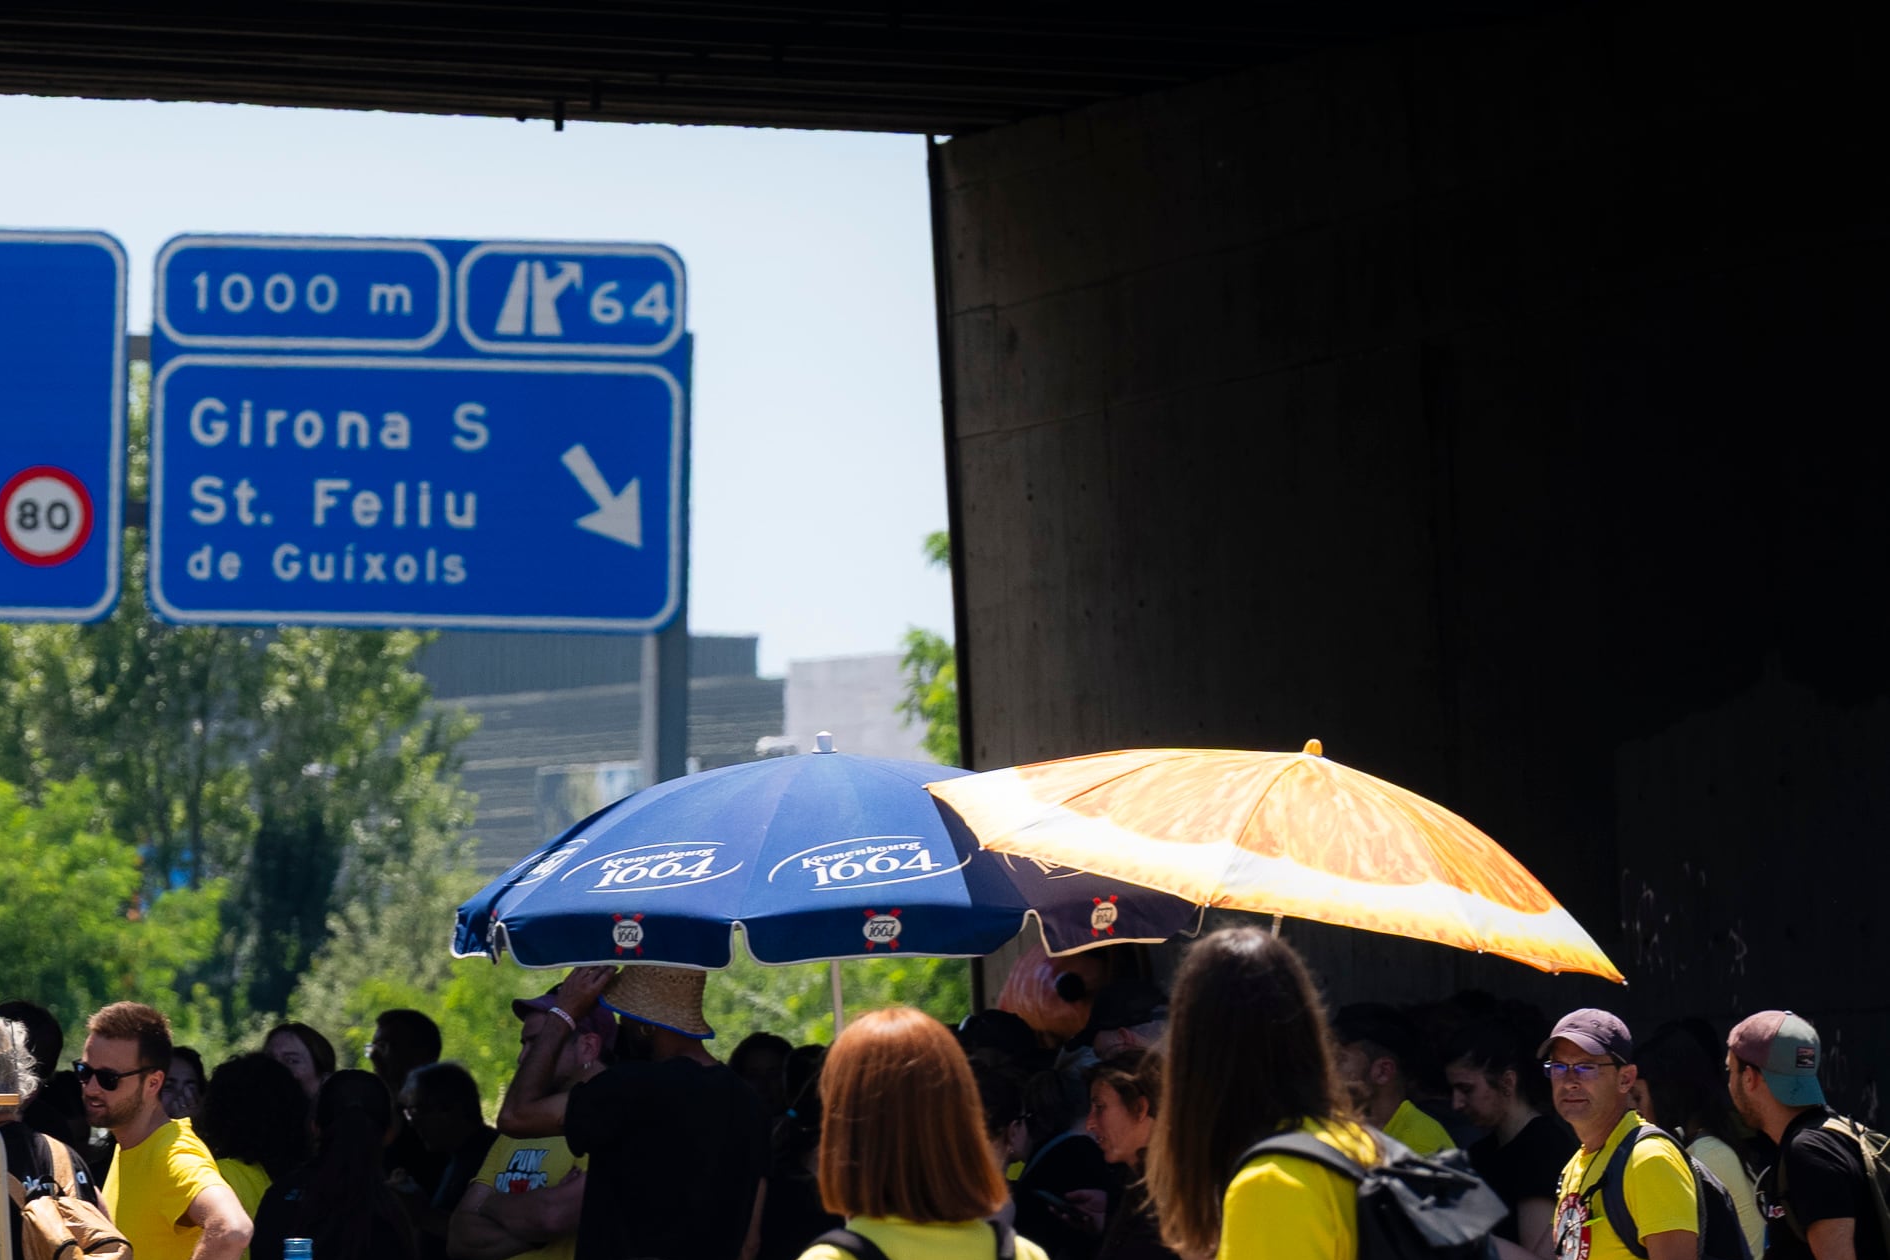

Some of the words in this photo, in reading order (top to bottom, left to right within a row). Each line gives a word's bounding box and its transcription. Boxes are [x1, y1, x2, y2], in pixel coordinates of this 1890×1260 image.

[192, 271, 339, 313] 1000
[369, 282, 413, 314] m
[589, 281, 672, 327] 64
[190, 397, 411, 449] Girona
[452, 402, 490, 451] S
[16, 498, 71, 532] 80
[190, 475, 274, 526] St.
[313, 478, 478, 528] Feliu
[187, 545, 241, 582] de
[273, 542, 468, 585] Guíxols
[594, 855, 716, 889] 1664
[802, 840, 921, 869] Kronenbourg
[814, 848, 941, 887] 1664
